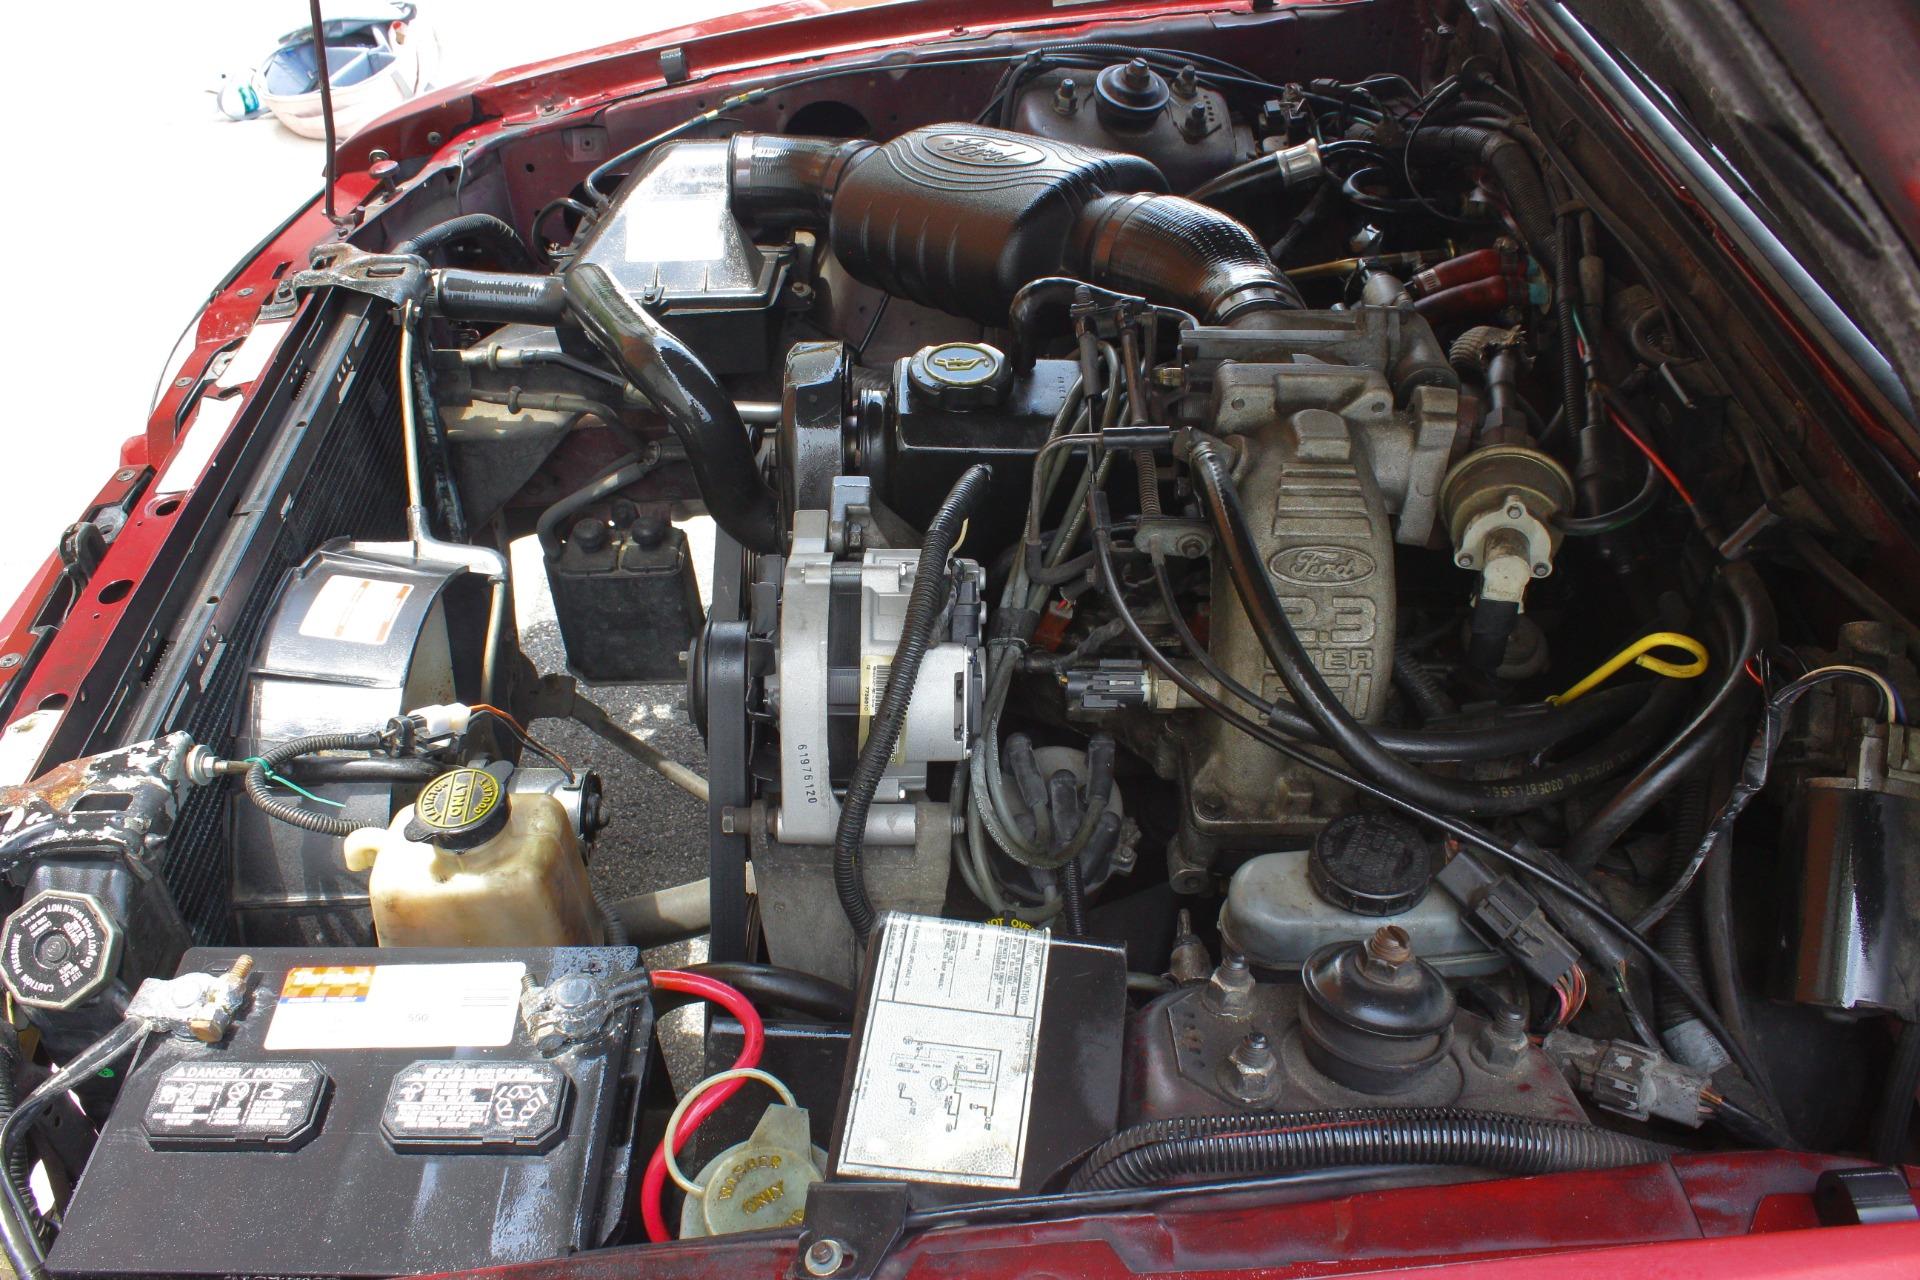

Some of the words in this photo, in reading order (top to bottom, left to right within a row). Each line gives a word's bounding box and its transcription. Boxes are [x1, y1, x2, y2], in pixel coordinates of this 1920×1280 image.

[937, 138, 1026, 162] Ford
[1290, 550, 1355, 580] Ford
[1278, 595, 1376, 644] 2.3
[796, 744, 818, 804] 61976120
[450, 784, 468, 816] ONLY
[474, 778, 494, 814] COOLANT
[46, 904, 62, 912] HOT
[64, 904, 84, 920] WHEN
[81, 919, 96, 938] OPEN
[11, 933, 24, 974] PRESSURE
[82, 956, 94, 968] DO
[20, 974, 54, 992] CAUTION
[188, 1066, 242, 1078] DANGER
[253, 1066, 303, 1078] POISON
[719, 1155, 782, 1200] WASHER
[742, 1178, 784, 1215] ONLY
